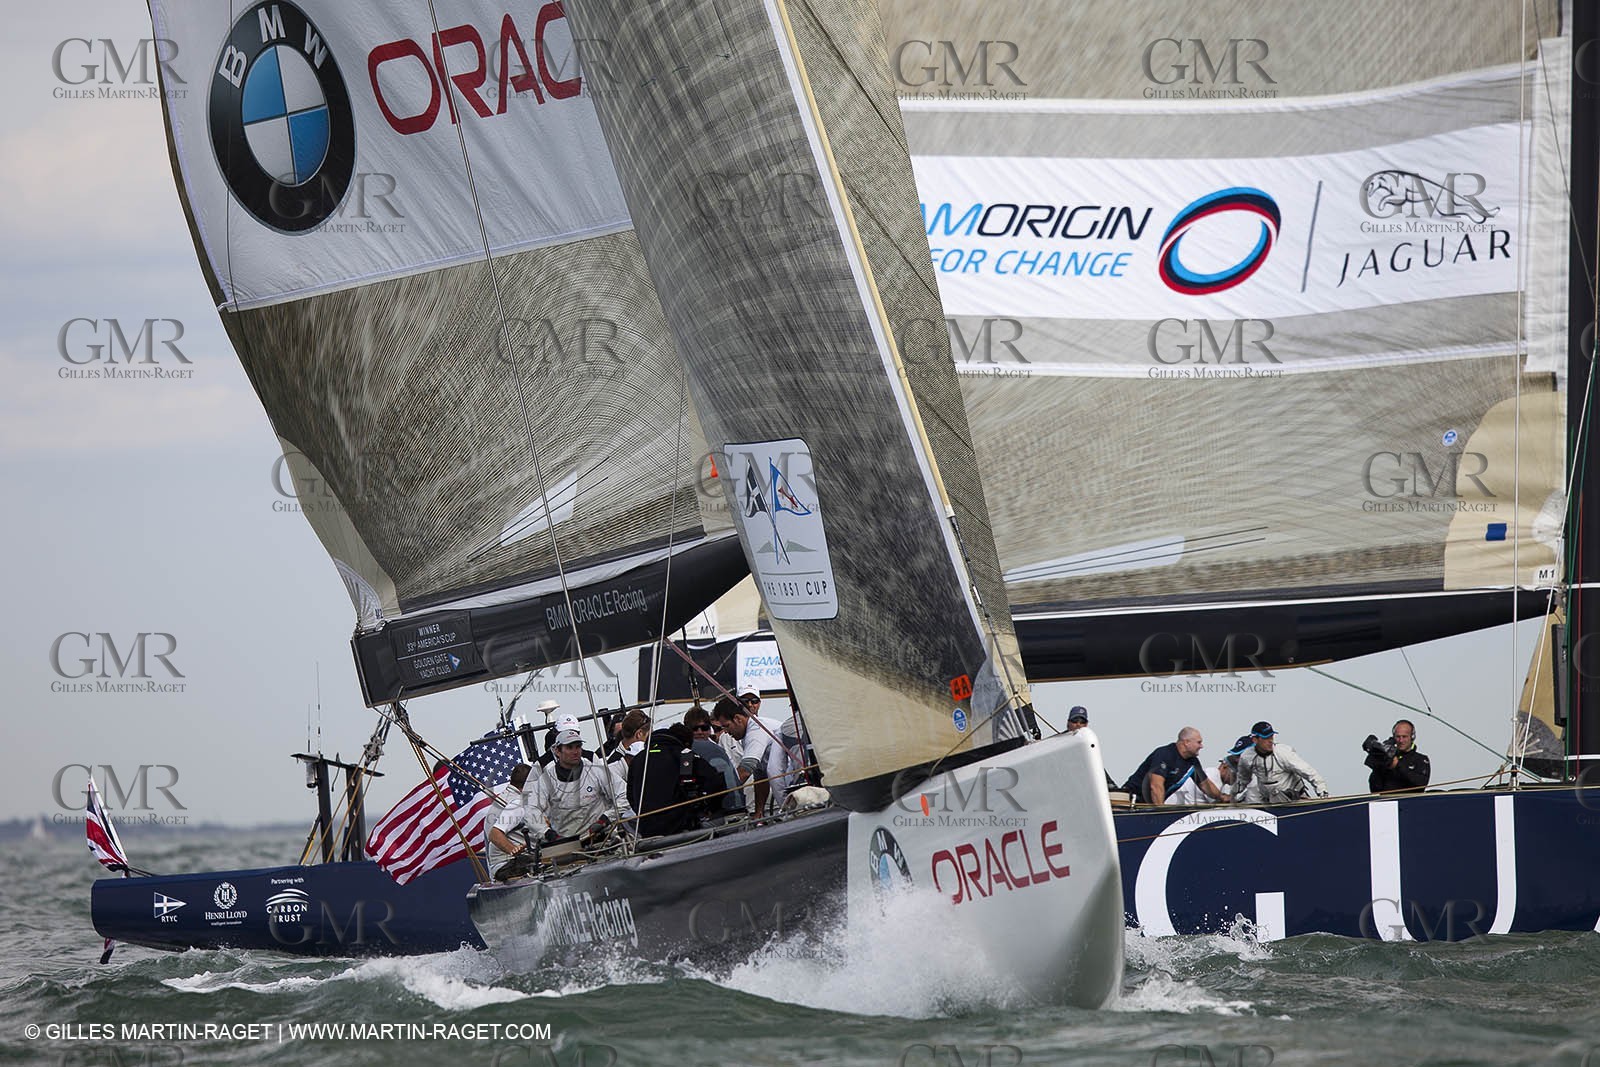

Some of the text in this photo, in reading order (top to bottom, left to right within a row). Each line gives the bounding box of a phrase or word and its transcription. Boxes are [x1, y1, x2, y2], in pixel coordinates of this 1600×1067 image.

[219, 4, 328, 89] BMW
[995, 250, 1132, 277] CHANGE
[1337, 229, 1511, 288] JAGUAR
[778, 581, 800, 597] 1851
[805, 580, 828, 596] CUP
[546, 586, 648, 631] BMW ORACLE Racing
[418, 624, 440, 637] WINNER
[414, 653, 449, 669] GOLDEN GATE
[932, 820, 1070, 904] ORACLE
[205, 910, 248, 920] HENRI LLOYD
[266, 904, 308, 914] CARBON
[161, 915, 178, 923] RTYC
[273, 913, 301, 923] TRUST
[583, 887, 639, 949] Racing
